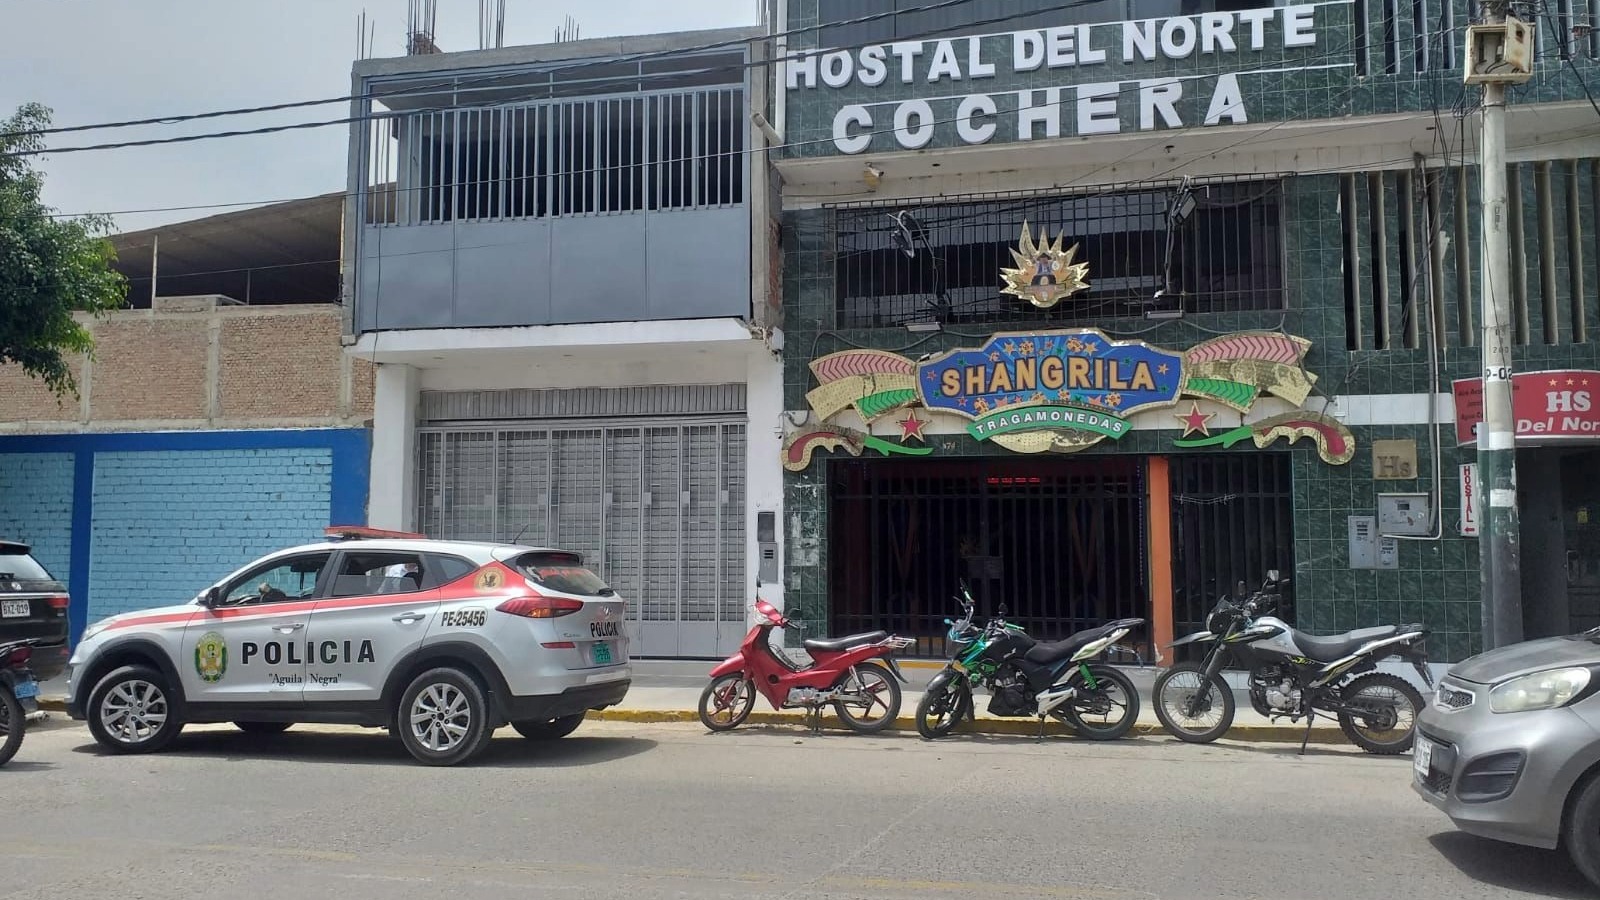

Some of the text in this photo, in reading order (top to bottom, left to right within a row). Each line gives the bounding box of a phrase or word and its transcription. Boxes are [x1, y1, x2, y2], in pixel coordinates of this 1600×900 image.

[786, 4, 1317, 90] HOSTAL DEL NORTE
[832, 73, 1248, 154] COCHERA
[941, 356, 1156, 397] SHANGRILA
[1546, 390, 1591, 413] HS
[976, 411, 1122, 434] TRAGAMONEDAS
[1516, 417, 1554, 433] Del
[1376, 455, 1413, 477] Hs
[1463, 465, 1474, 523] HOSTAL
[441, 610, 486, 627] PE-25456
[590, 621, 619, 638] POLICIA
[241, 640, 376, 665] POLICIA
[268, 673, 342, 686] "Aguila Negra"
